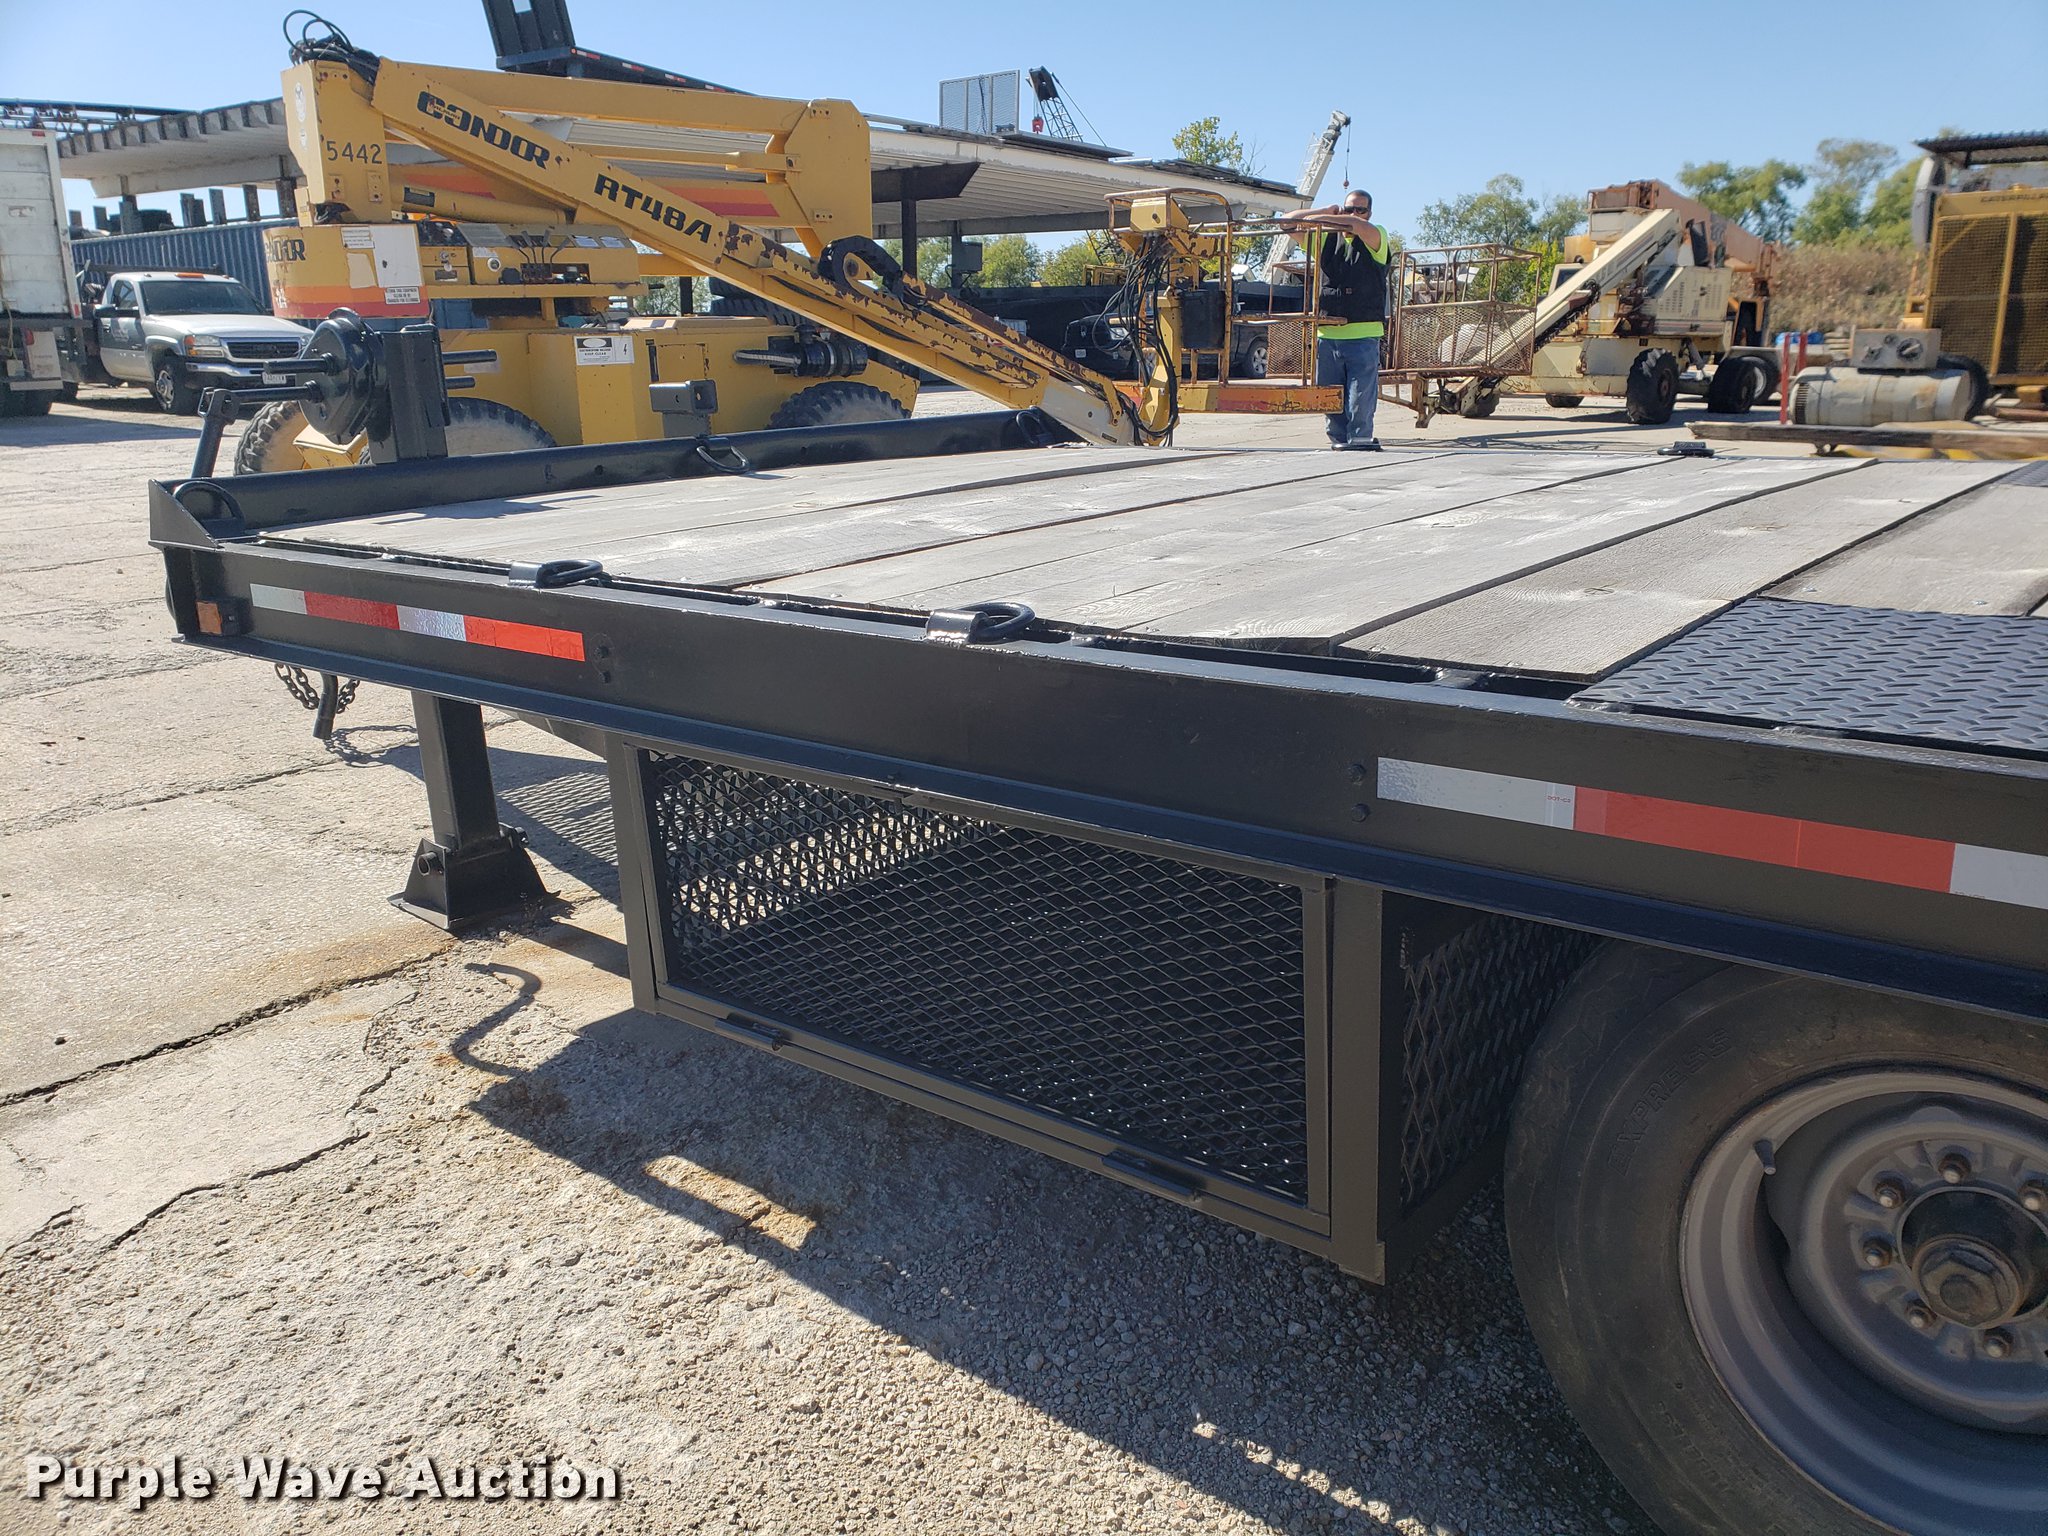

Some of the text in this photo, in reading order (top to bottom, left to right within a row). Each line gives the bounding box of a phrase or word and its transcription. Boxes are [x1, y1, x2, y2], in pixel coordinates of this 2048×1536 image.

[326, 140, 383, 165] 5442
[416, 91, 551, 170] CONDOR
[593, 173, 713, 244] RT48A
[1608, 1027, 1733, 1176] EXPRESS
